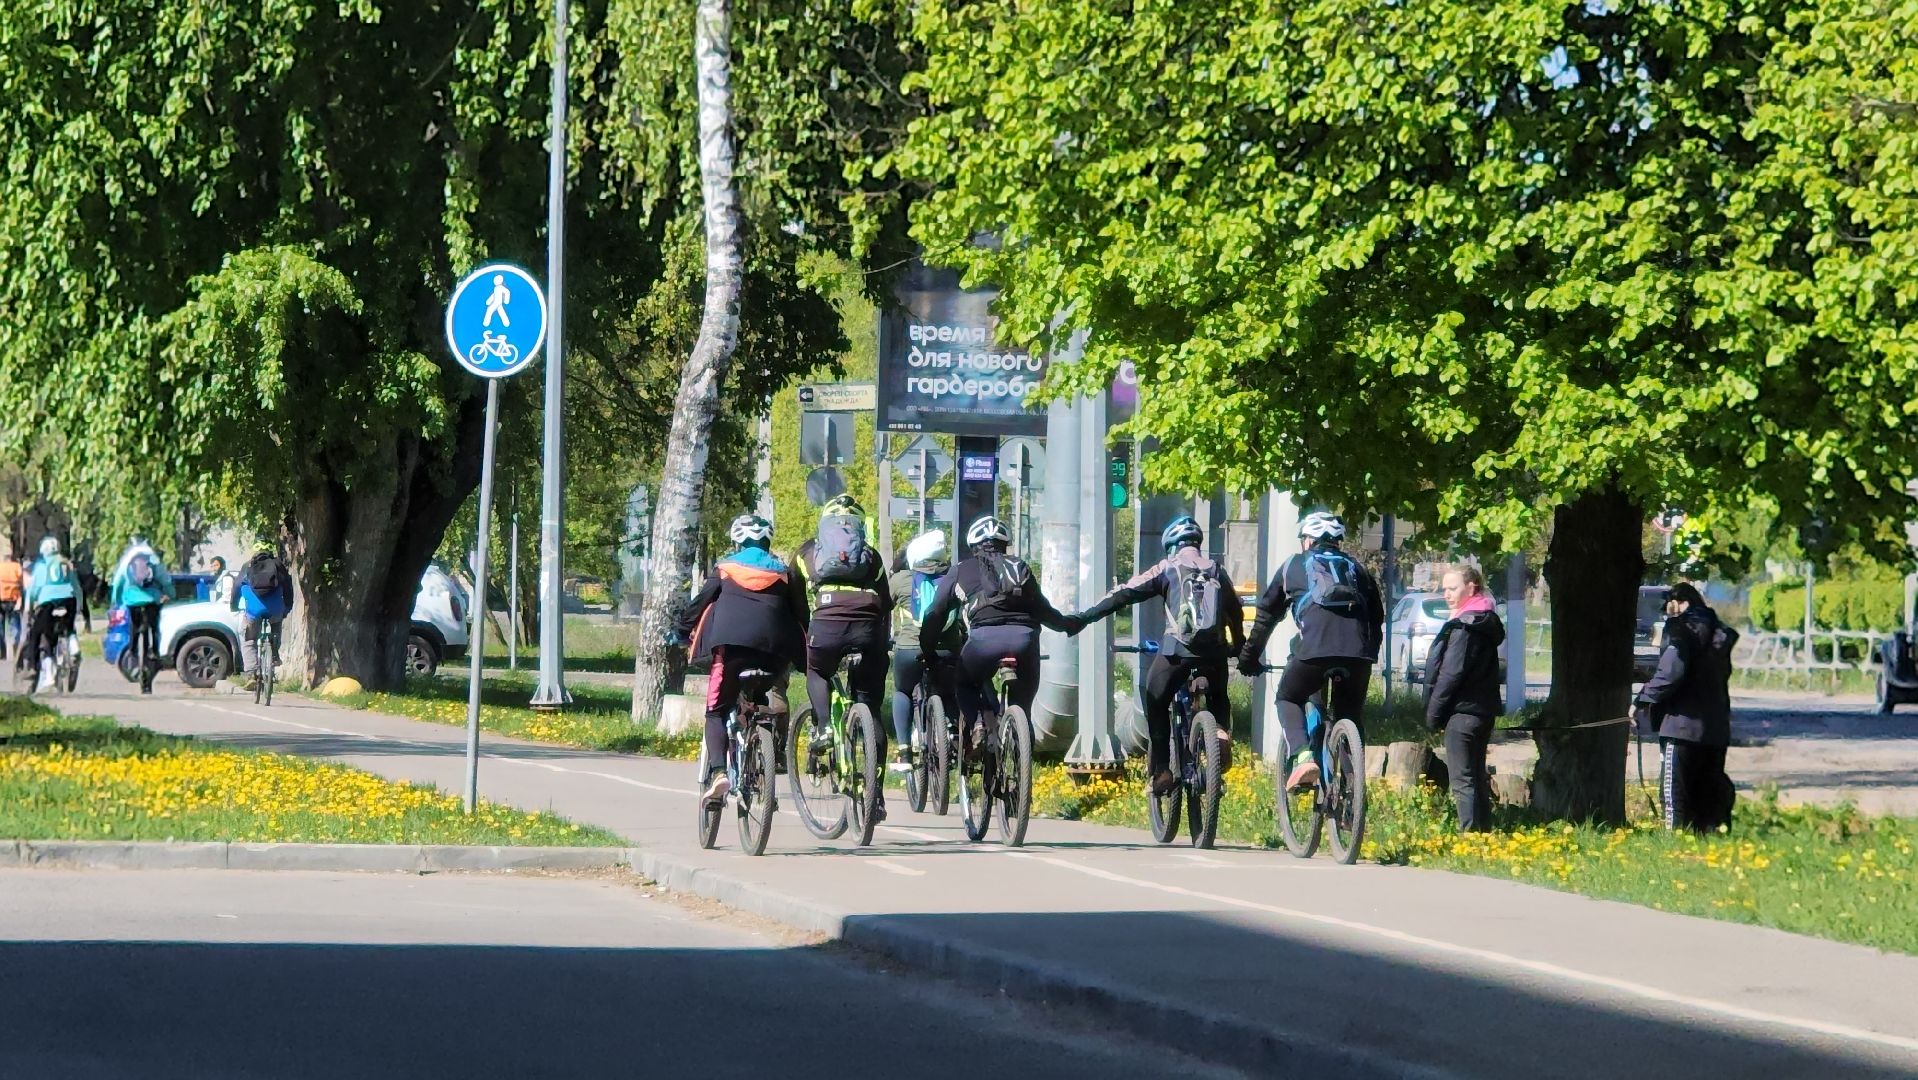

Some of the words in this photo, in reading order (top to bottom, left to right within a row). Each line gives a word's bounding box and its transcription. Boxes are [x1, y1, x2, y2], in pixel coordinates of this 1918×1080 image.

[909, 324, 986, 346] время
[907, 345, 951, 368] для
[958, 352, 1043, 372] нового
[1112, 462, 1126, 477] 29
